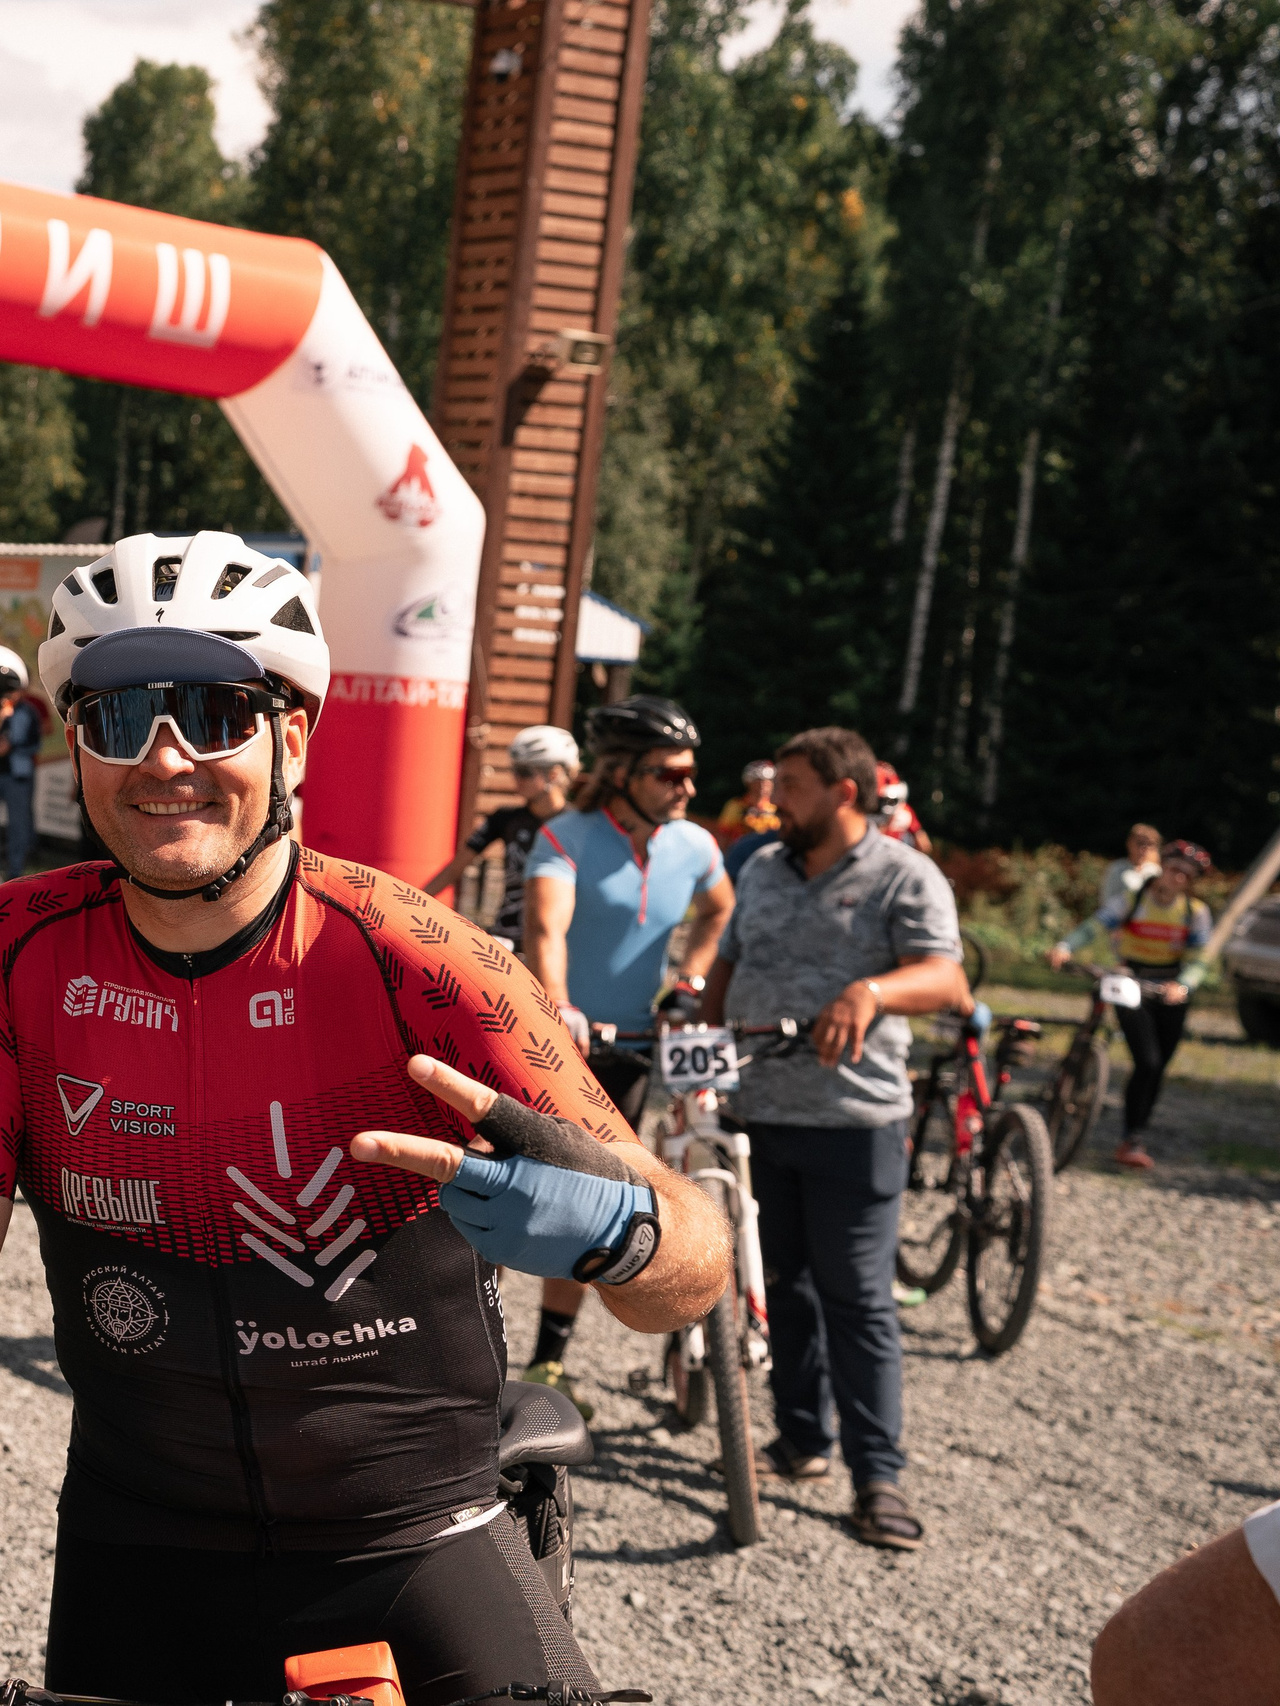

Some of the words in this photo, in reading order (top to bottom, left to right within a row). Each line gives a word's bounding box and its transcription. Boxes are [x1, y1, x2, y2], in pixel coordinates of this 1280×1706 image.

[669, 1044, 729, 1077] 205
[110, 1099, 175, 1119] SPORT
[109, 1117, 175, 1137] VISION
[61, 1166, 166, 1225] ПРЕВЫШЕ
[82, 1265, 127, 1285] РУССКИЙ
[131, 1271, 166, 1300] АЛТАЙ
[483, 1279, 495, 1308] pro
[133, 1334, 166, 1355] ALTAY
[290, 1356, 328, 1368] штаб
[332, 1349, 379, 1364] лыжни
